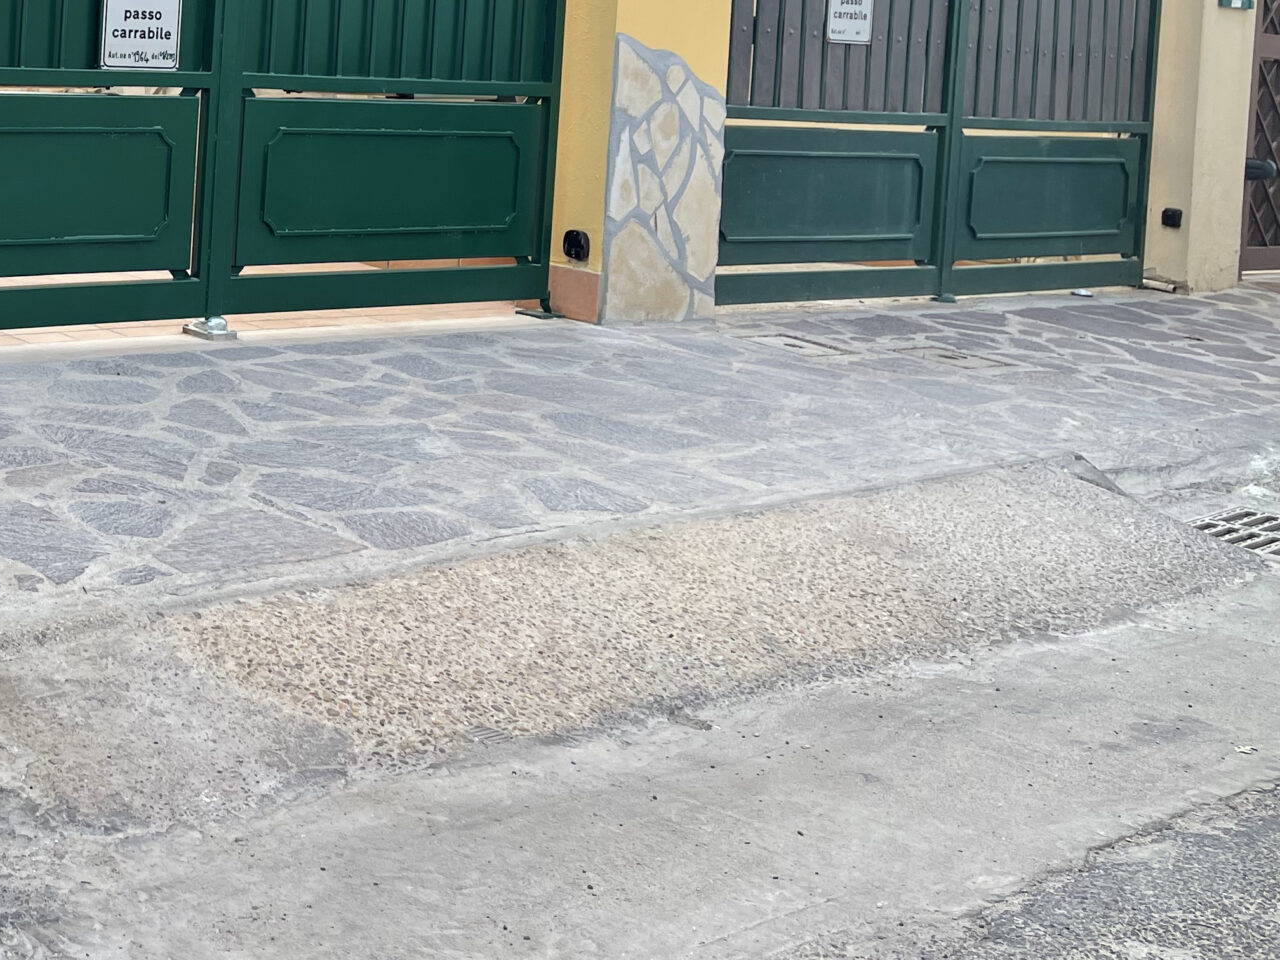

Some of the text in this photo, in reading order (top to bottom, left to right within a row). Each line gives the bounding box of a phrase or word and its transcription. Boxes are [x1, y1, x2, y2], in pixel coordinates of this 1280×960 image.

[124, 9, 162, 21] passo
[833, 10, 868, 21] carrabile
[112, 26, 171, 40] carrabile
